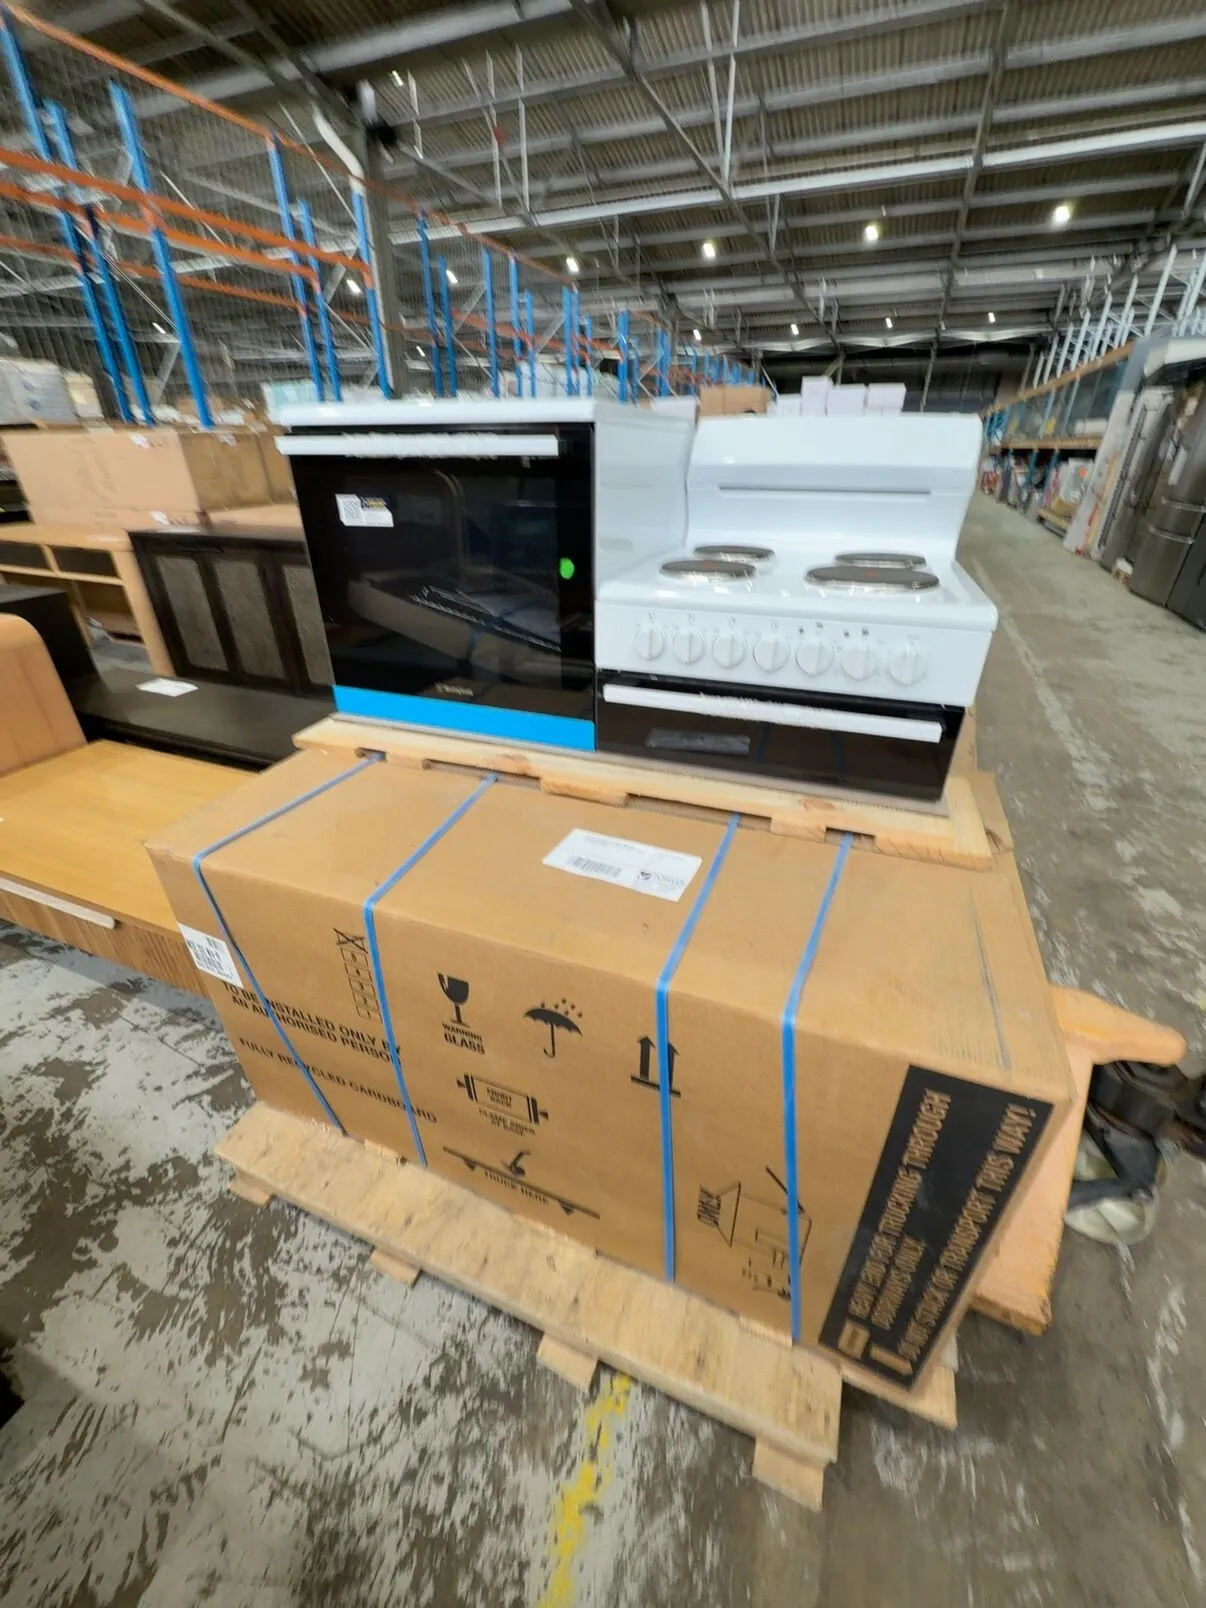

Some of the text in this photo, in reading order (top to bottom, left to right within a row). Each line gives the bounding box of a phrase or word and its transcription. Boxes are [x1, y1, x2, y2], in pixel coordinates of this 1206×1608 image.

[222, 981, 239, 995] TO
[243, 990, 260, 1003] BE
[265, 997, 335, 1031] NSTALLED
[339, 1024, 376, 1046] ONLY
[232, 995, 249, 1009] AN
[252, 1003, 337, 1042] AUHORISED
[239, 1036, 274, 1058] FULLY
[278, 1053, 346, 1086] REYCLED
[444, 1033, 485, 1055] GLASS
[993, 1102, 1037, 1154] WAY!
[879, 1167, 922, 1235] TRUCKING
[903, 1089, 951, 1169] THROUGH
[975, 1150, 1015, 1192] THIS
[939, 1188, 997, 1272] TRANSPORT
[929, 1265, 958, 1290] OR
